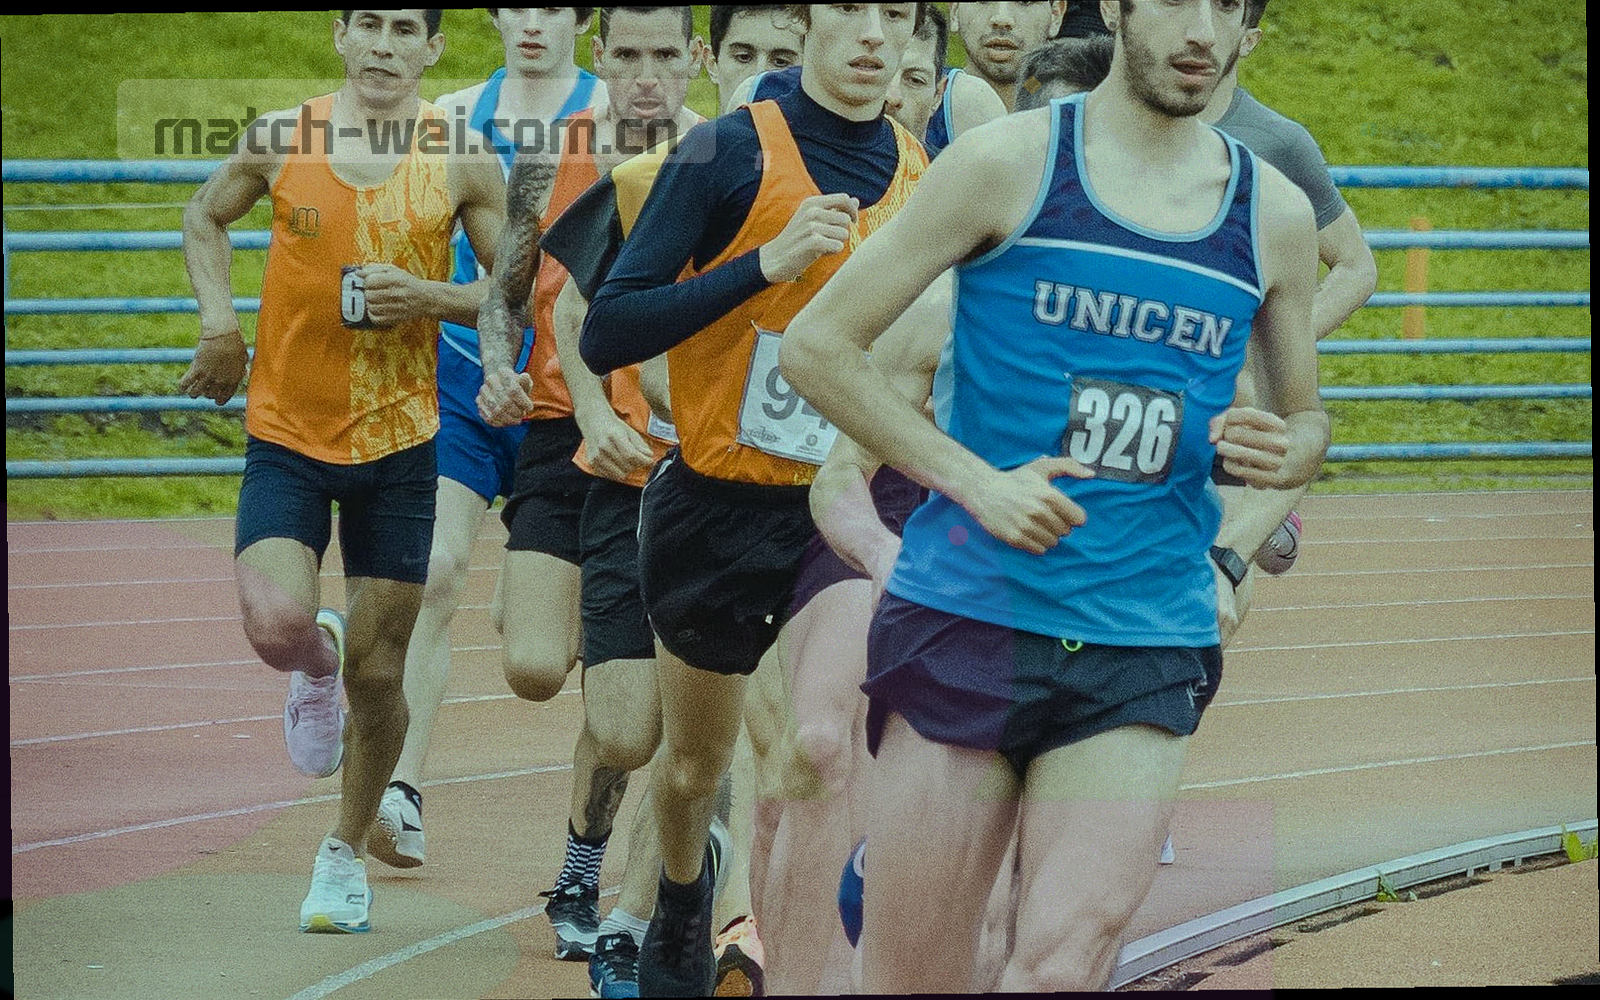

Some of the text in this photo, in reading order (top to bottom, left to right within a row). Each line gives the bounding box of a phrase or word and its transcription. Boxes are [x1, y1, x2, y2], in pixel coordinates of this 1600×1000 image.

[341, 271, 366, 322] 6
[1032, 279, 1233, 358] UNICEN
[1069, 387, 1176, 475] 326
